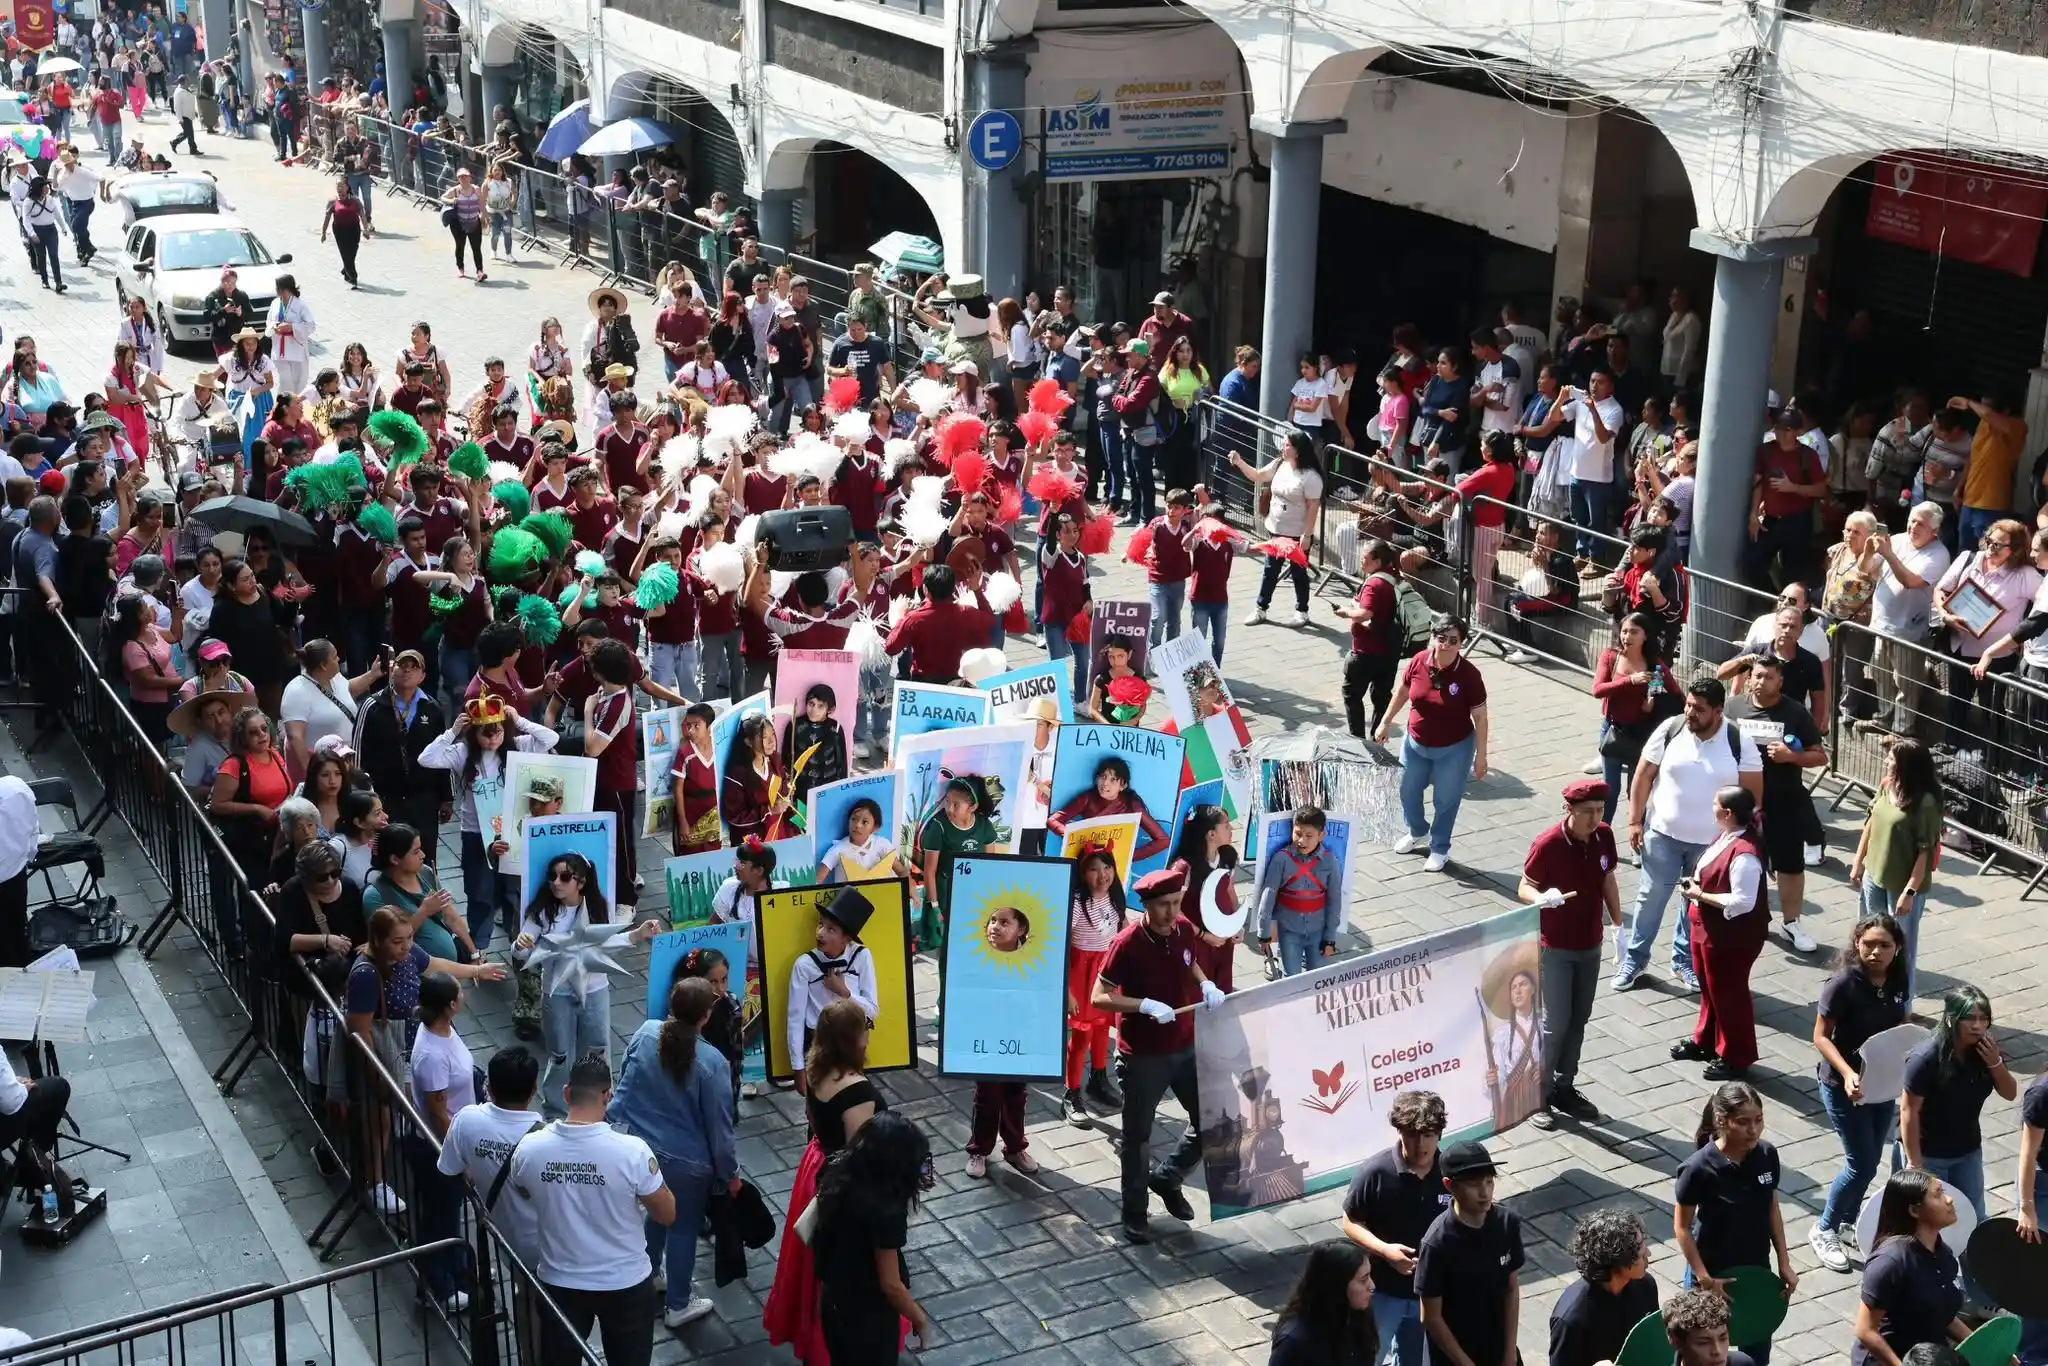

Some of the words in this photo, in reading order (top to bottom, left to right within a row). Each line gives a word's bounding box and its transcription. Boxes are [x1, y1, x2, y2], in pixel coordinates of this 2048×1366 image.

[983, 121, 1007, 160] E
[1116, 602, 1138, 617] La
[1105, 619, 1146, 637] Rosa
[786, 650, 805, 661] LA
[813, 651, 854, 663] MUERTE
[900, 689, 916, 703] 33
[991, 688, 1008, 707] EL
[1010, 675, 1056, 701] MUSICO
[901, 703, 920, 717] LA
[922, 705, 977, 724] ARAÑA
[1075, 727, 1101, 747] LA
[1110, 729, 1166, 761] SIRENA
[840, 782, 850, 791] LA
[531, 827, 546, 838] LA
[550, 822, 606, 836] ESTRELLA
[955, 861, 972, 875] 46
[681, 871, 700, 885] 48
[766, 898, 775, 909] 4
[792, 894, 806, 907] EL
[815, 889, 839, 904] CAT
[692, 926, 728, 944] DAMA
[1314, 975, 1336, 990] CXV
[1337, 957, 1401, 984] ANIVERSARIO
[1403, 953, 1417, 965] DE
[1419, 948, 1430, 959] LA
[1315, 960, 1433, 1015] REVOLUCIÓN
[1327, 988, 1425, 1032] MEXICANA
[973, 1039, 989, 1054] EL
[998, 1039, 1023, 1055] SOL
[1371, 1040, 1434, 1070] Colegio
[1373, 1057, 1461, 1093] Esperanza
[545, 1161, 597, 1174] COMUNICACIÓN
[541, 1172, 563, 1184] SSPC
[565, 1173, 605, 1186] MORELOS
